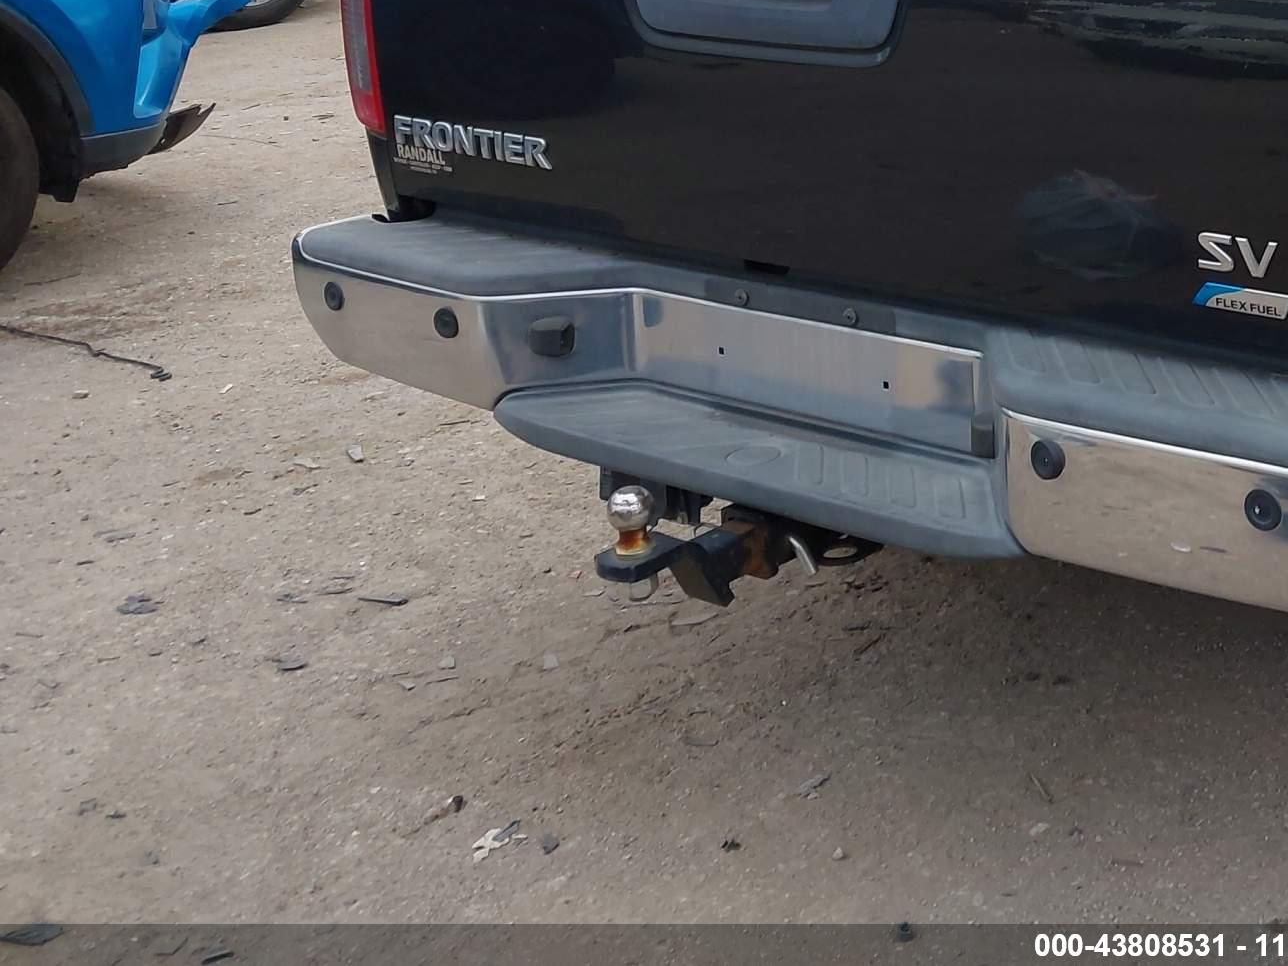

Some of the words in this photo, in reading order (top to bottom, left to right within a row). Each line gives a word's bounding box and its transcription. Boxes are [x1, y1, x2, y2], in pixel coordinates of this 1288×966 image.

[394, 114, 552, 170] FRONTIER
[396, 144, 446, 165] RANDALL
[1198, 232, 1278, 278] SV
[1215, 297, 1248, 312] FLEX
[1249, 302, 1282, 317] FUEL
